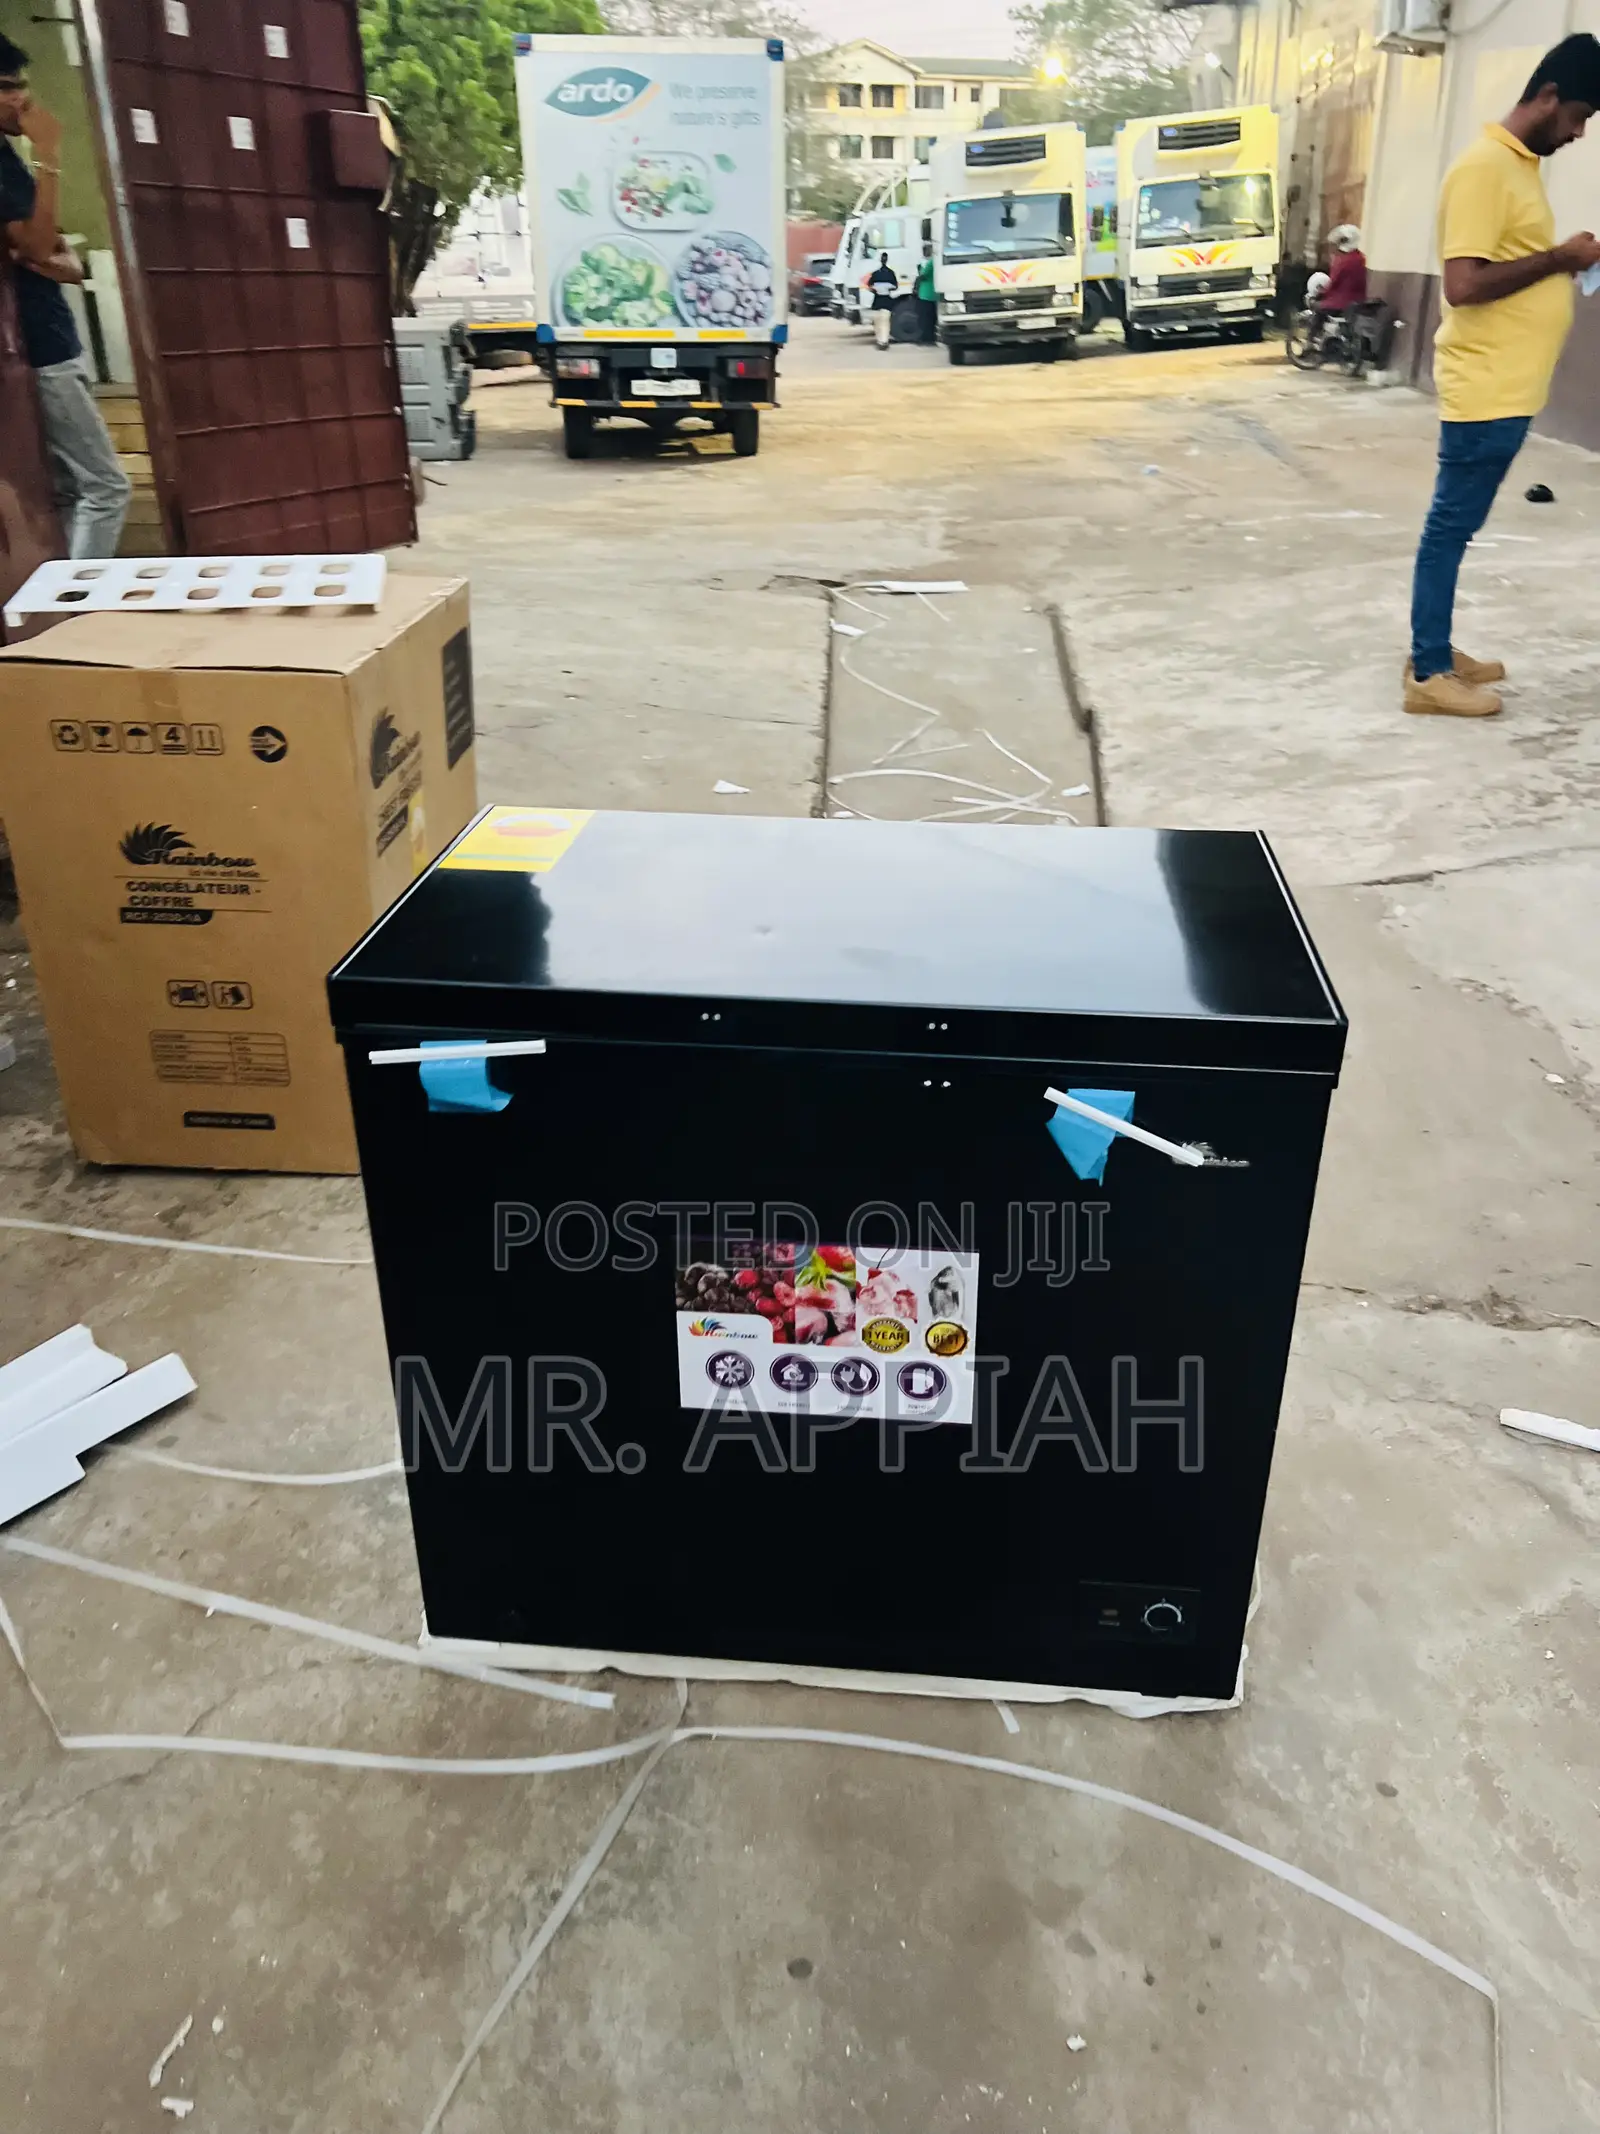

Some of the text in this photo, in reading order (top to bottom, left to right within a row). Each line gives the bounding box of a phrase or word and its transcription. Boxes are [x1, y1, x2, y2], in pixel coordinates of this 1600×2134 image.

[557, 77, 635, 103] ardo
[128, 895, 195, 908] COFFRE
[874, 1331, 905, 1341] YEAR
